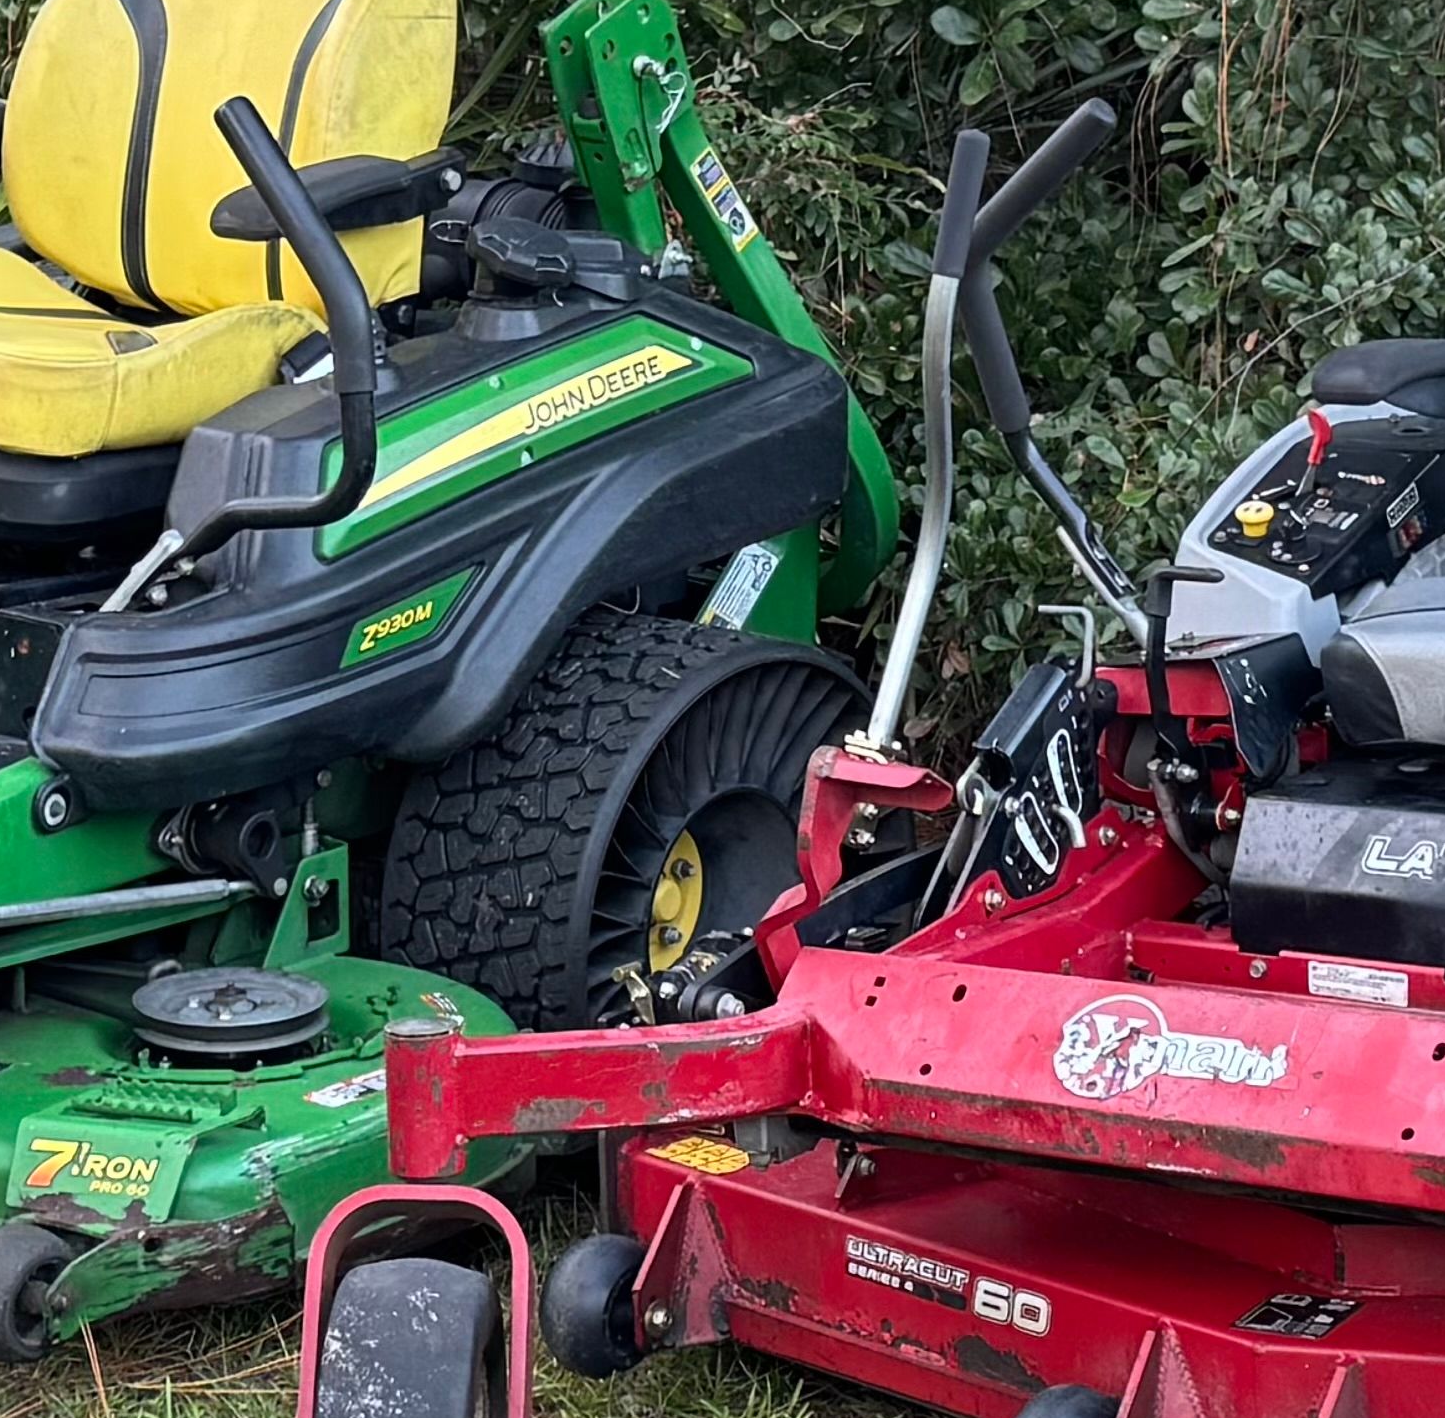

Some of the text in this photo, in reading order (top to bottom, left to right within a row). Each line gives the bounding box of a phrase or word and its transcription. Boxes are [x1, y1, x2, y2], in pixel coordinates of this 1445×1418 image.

[525, 355, 662, 429] JOHN DEERE
[359, 601, 433, 652] Z930M
[89, 1180, 123, 1194] PRO
[846, 1236, 969, 1290] ULTRACUT
[973, 1276, 1052, 1337] 60
